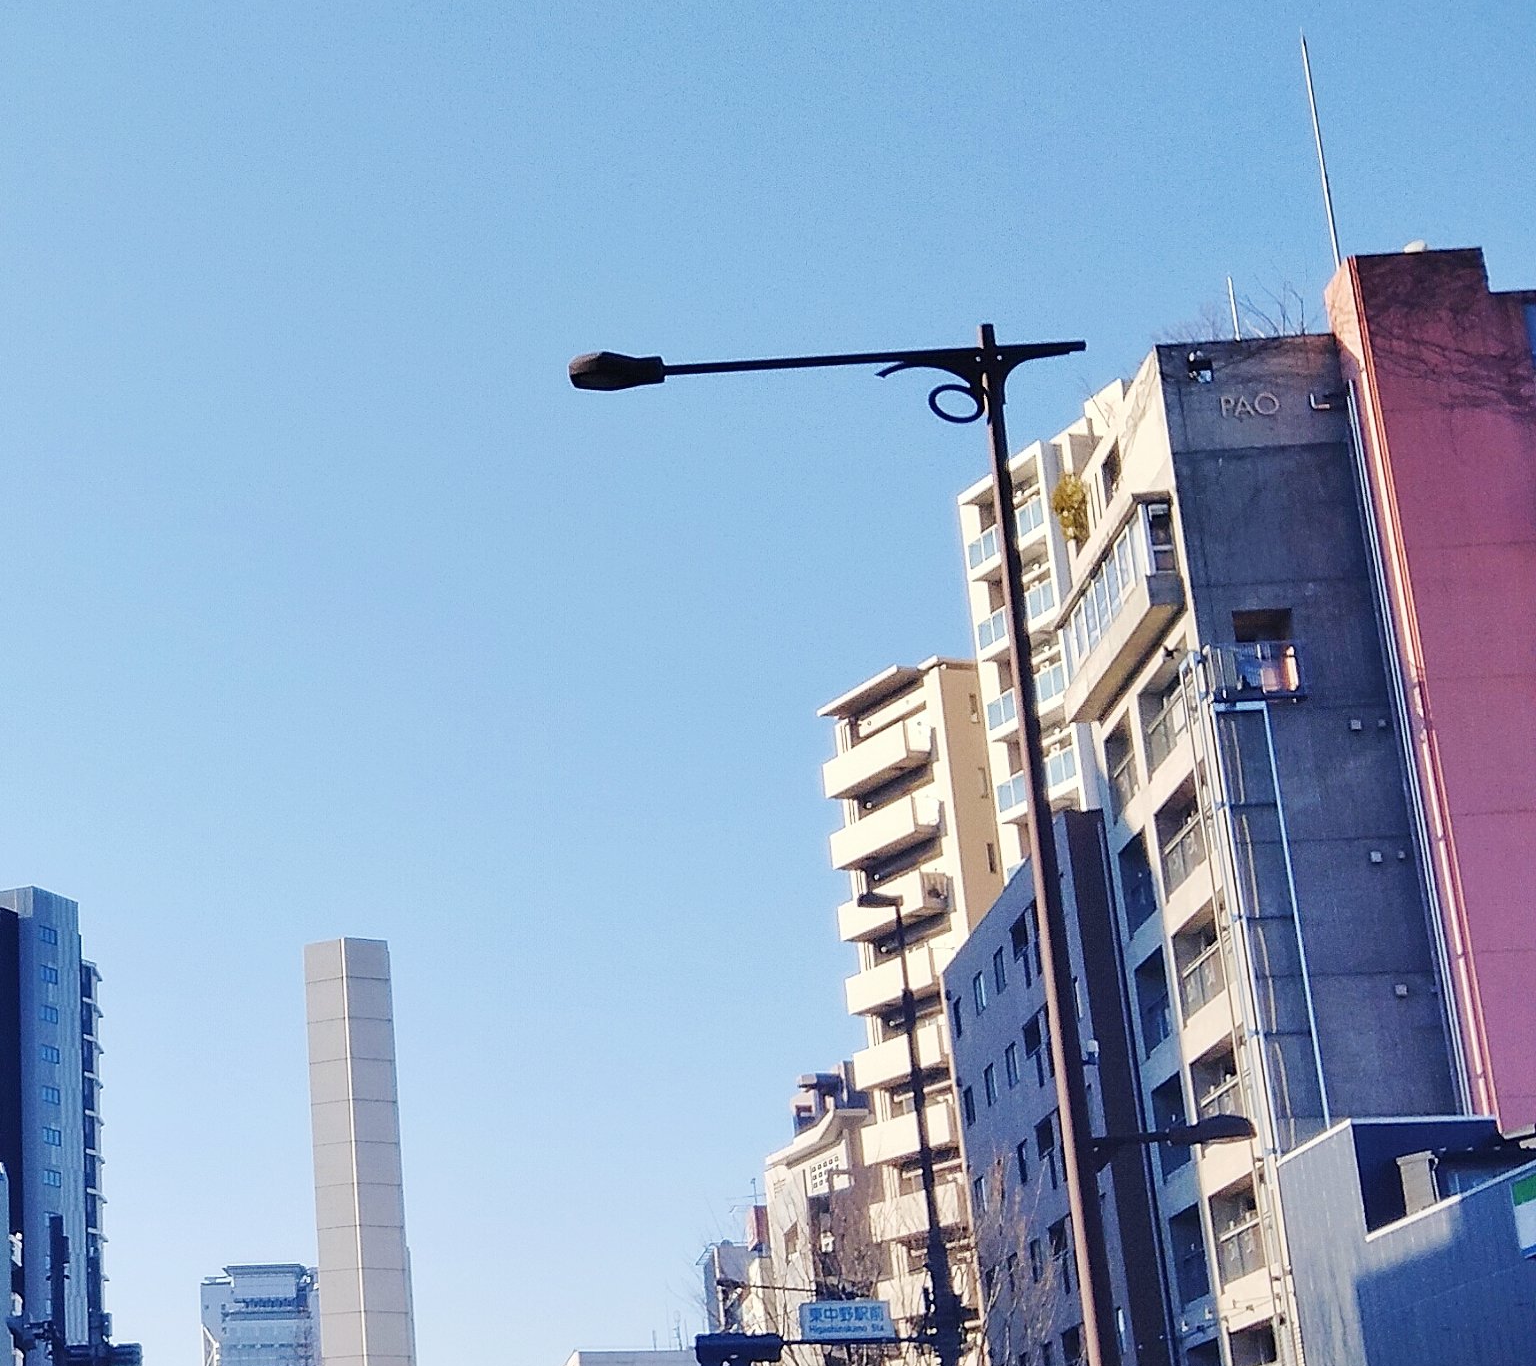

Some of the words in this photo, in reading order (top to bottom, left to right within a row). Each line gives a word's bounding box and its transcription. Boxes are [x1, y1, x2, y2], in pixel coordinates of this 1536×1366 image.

[1220, 392, 1280, 417] PAO
[809, 1306, 883, 1322] 東中野駅前
